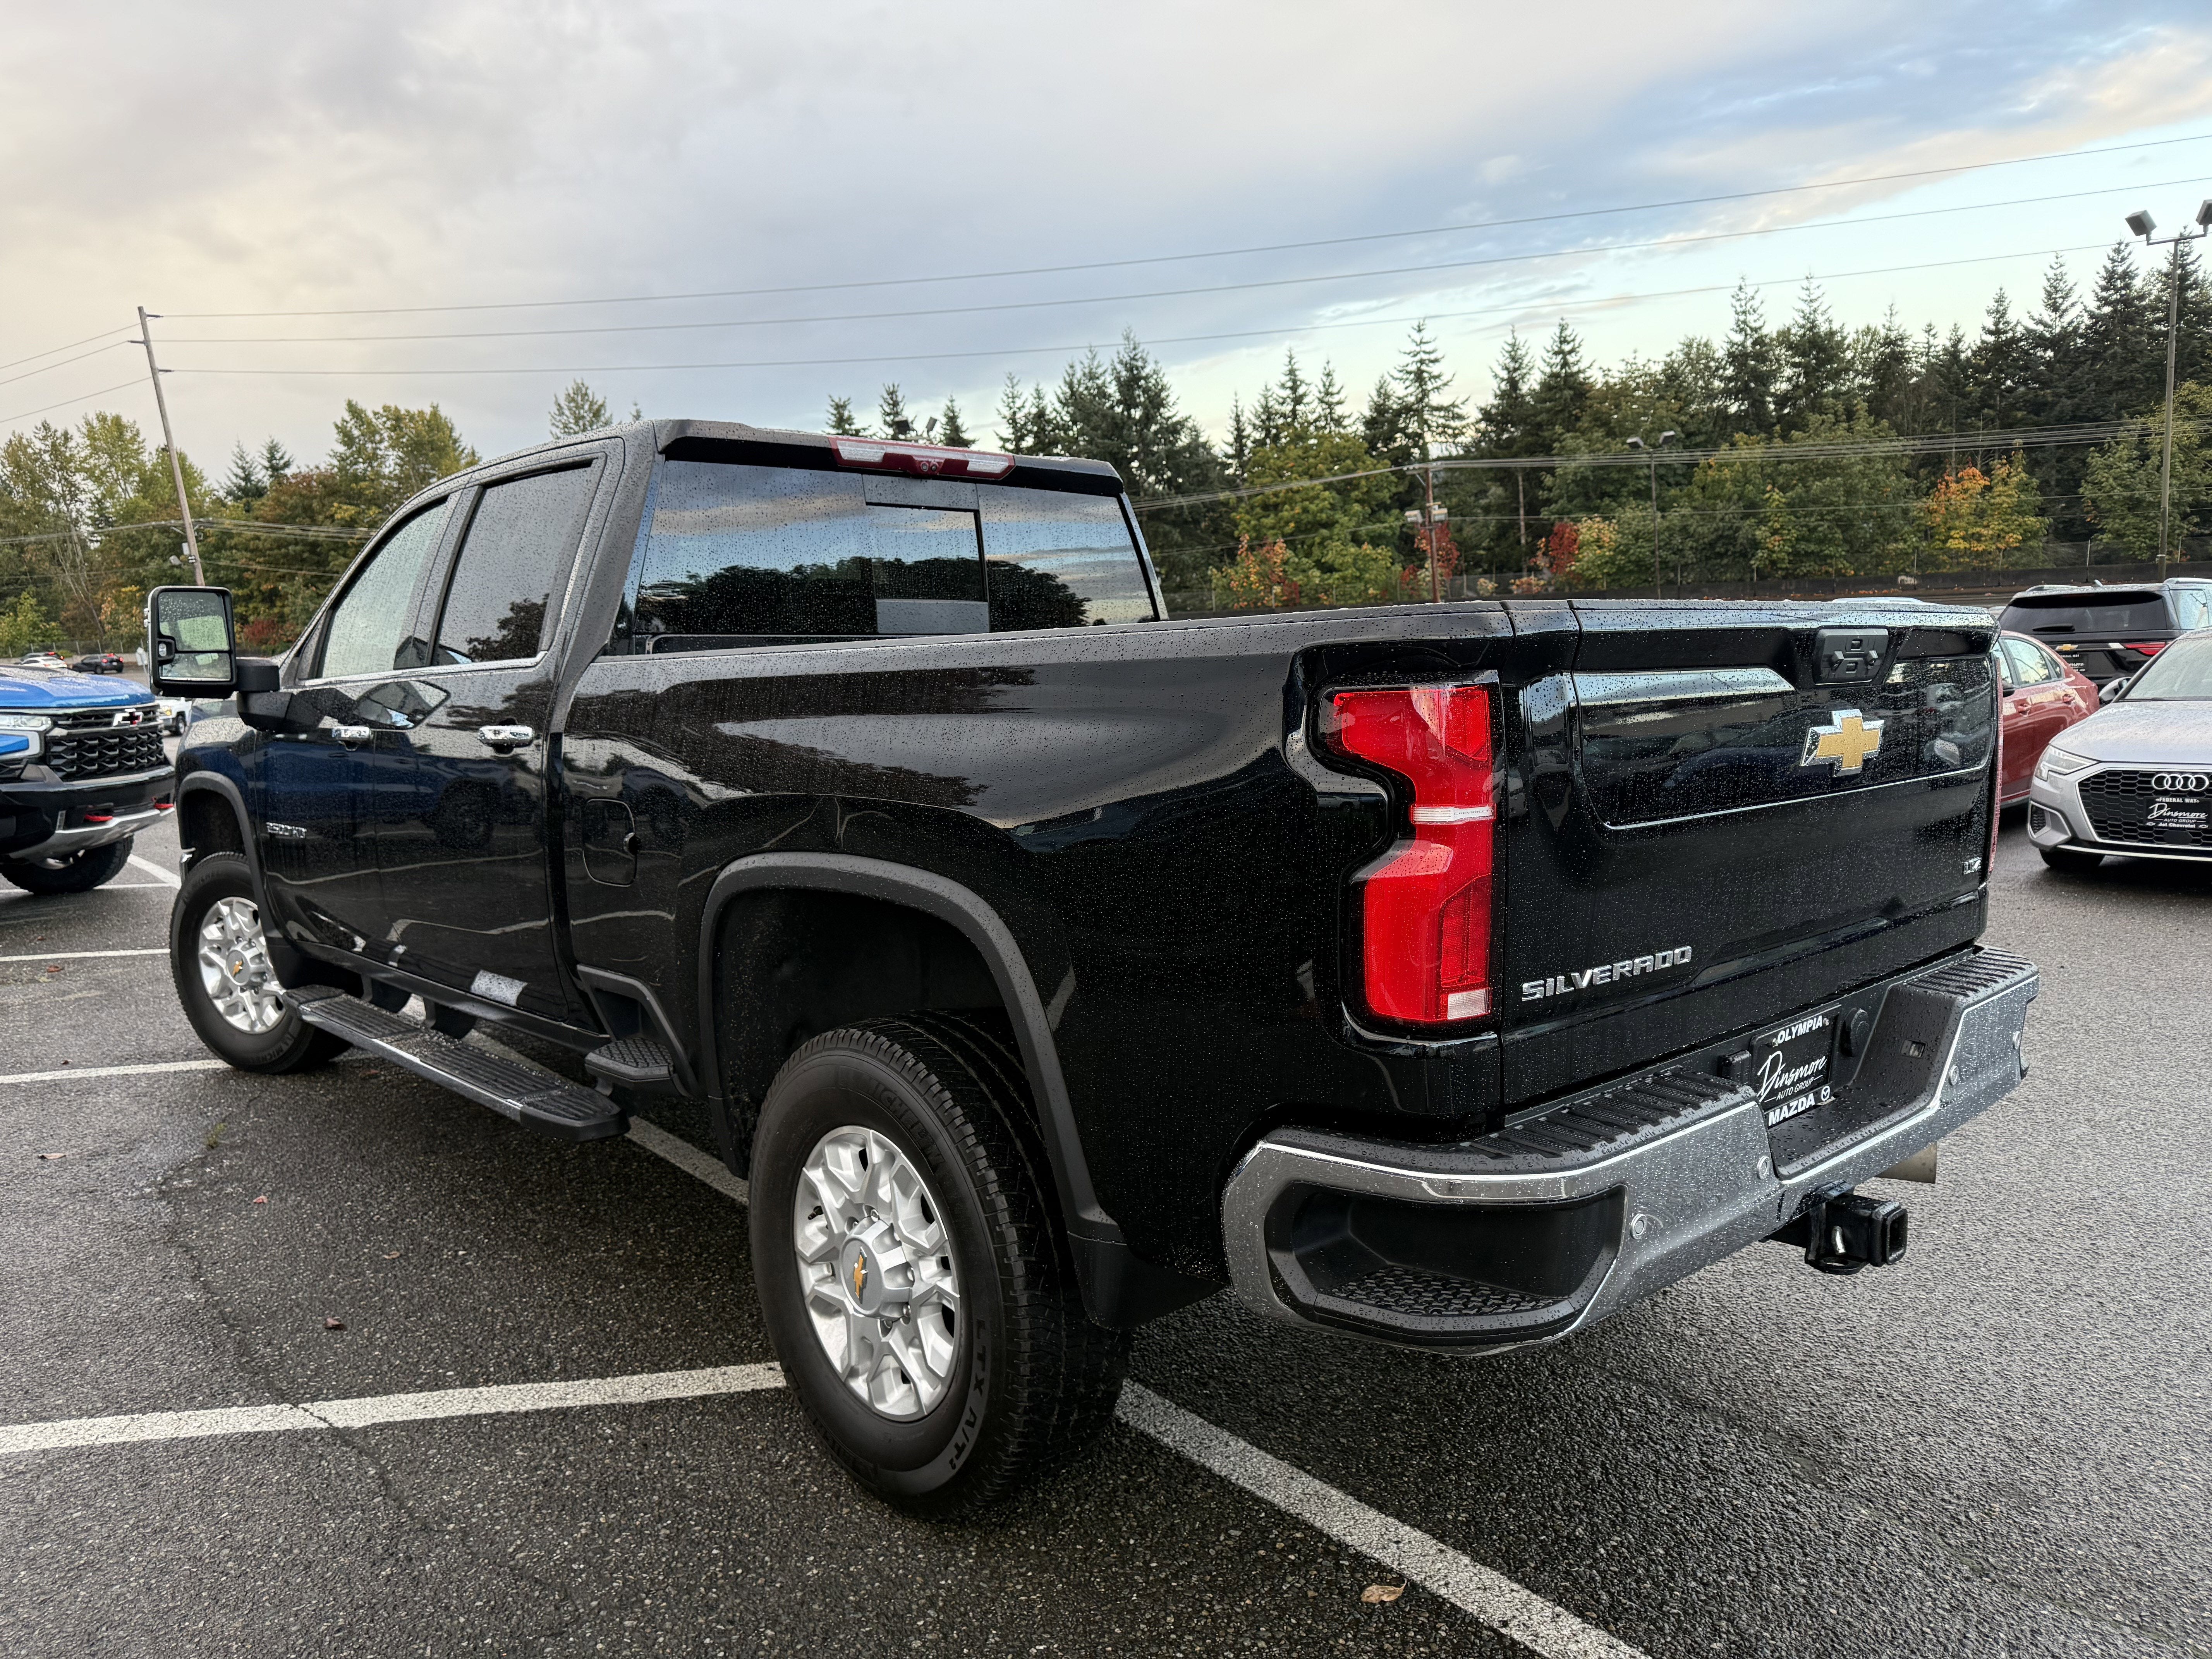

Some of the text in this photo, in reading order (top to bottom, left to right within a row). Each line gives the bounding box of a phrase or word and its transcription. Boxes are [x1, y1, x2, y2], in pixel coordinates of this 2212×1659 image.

[2147, 802, 2209, 819] Dinsmore
[1522, 946, 1692, 1001] SILVERADO
[1777, 1015, 1822, 1044] OLYMPIA
[1756, 1050, 1827, 1103] Dinsmore
[1776, 1077, 1814, 1101] AUTO GROUP
[857, 1072, 944, 1173] ICHELIN
[1768, 1093, 1815, 1126] MAZDA
[973, 1318, 986, 1397] LTX
